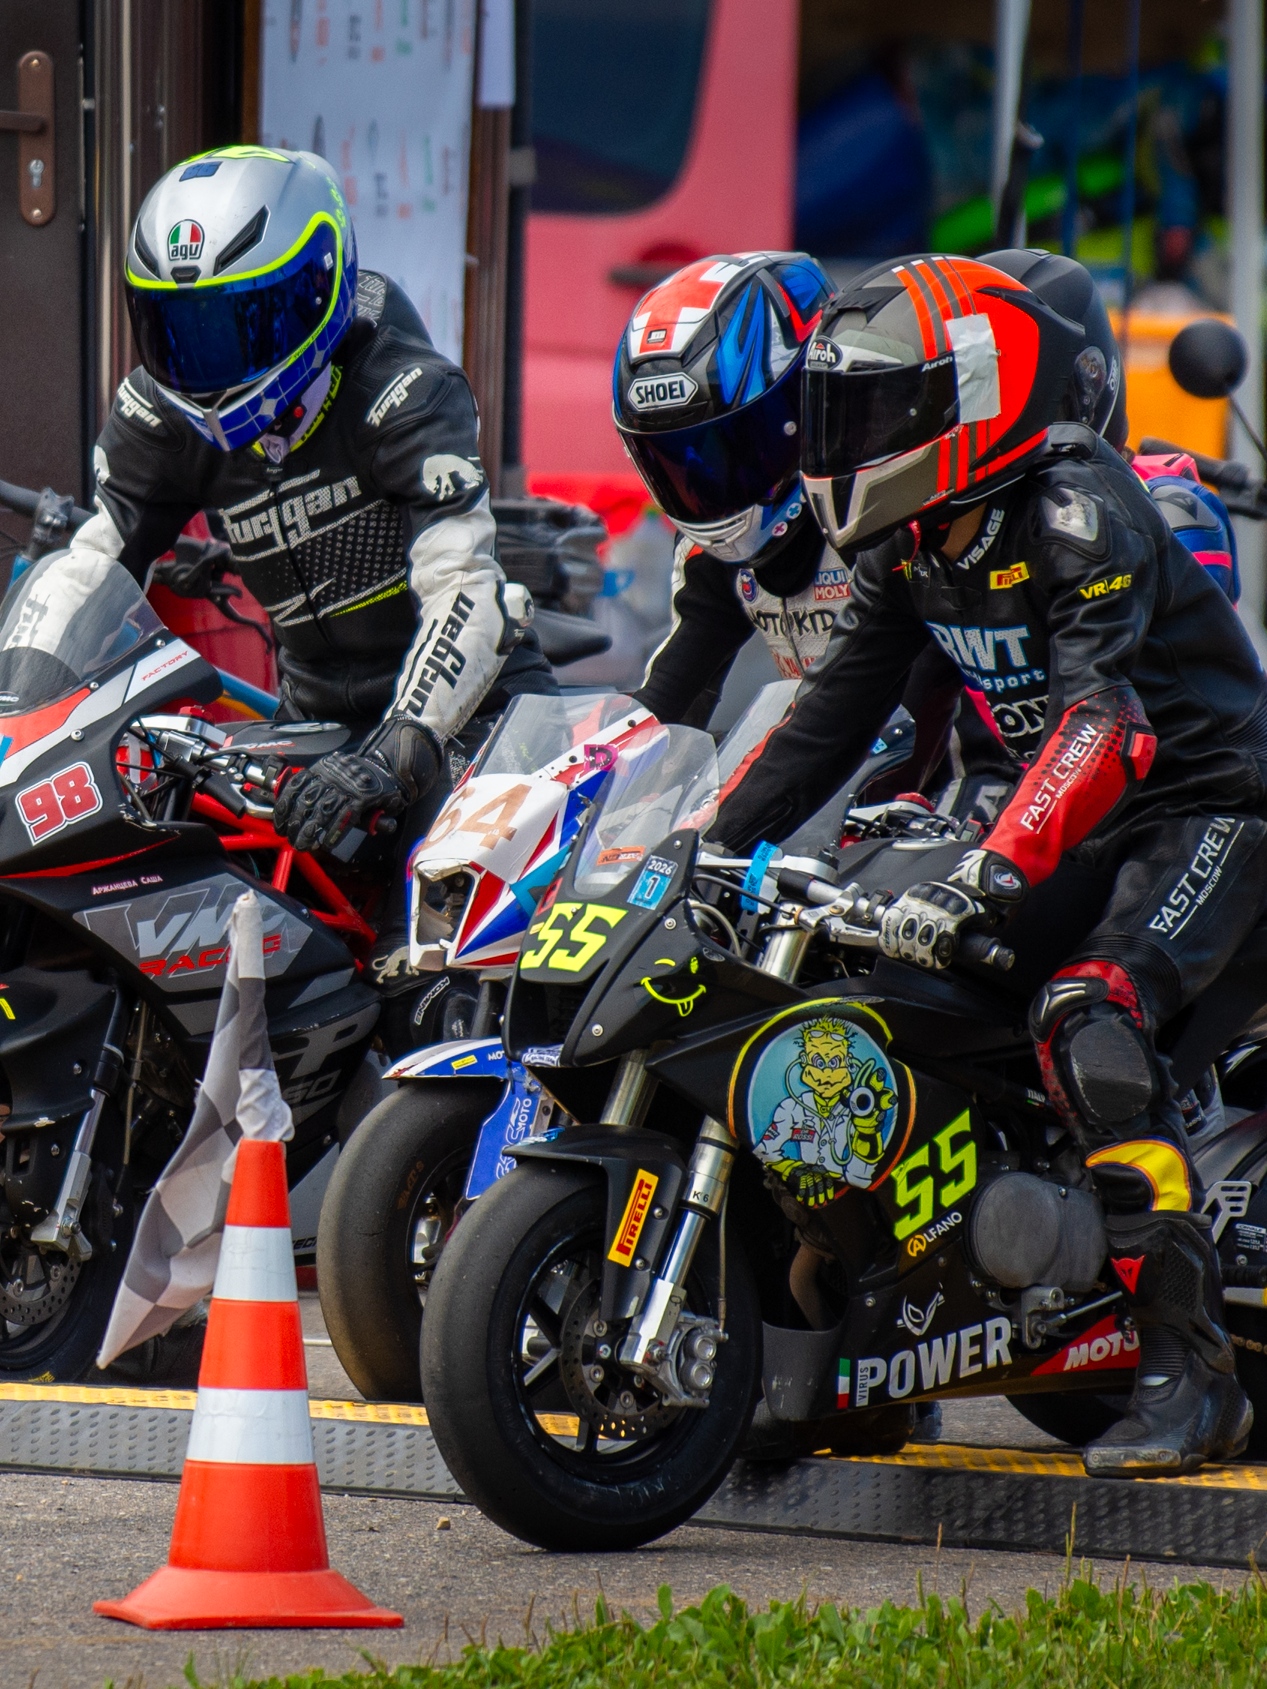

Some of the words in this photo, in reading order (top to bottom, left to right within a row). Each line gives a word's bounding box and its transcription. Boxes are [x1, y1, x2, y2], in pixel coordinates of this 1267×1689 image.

[171, 245, 200, 260] agv
[808, 342, 836, 363] Airoh
[922, 355, 953, 372] Airoh
[635, 378, 686, 404] SHOEI
[957, 508, 1005, 570] VISAGE
[816, 584, 850, 600] MOLY
[141, 651, 188, 681] FACTORY
[393, 591, 475, 719] urygan
[926, 621, 1031, 671] RWT
[1020, 778, 1056, 831] FAST
[1053, 723, 1097, 780] CREW
[1055, 767, 1082, 799] MOSCOW
[15, 761, 103, 847] 98
[644, 875, 661, 899] 1
[648, 860, 674, 875] 2026
[1149, 873, 1196, 933] FAST
[1190, 816, 1236, 877] CREW
[1195, 866, 1223, 906] MOSCOW
[521, 903, 629, 973] 55
[516, 1098, 532, 1131] MOTO
[893, 1109, 977, 1241] 55
[615, 1178, 653, 1257] PIRELLI
[906, 1211, 963, 1258] ALFANO
[864, 1317, 1013, 1400] POWER
[1063, 1330, 1140, 1372] MOTU
[857, 1366, 868, 1402] VIRUS
